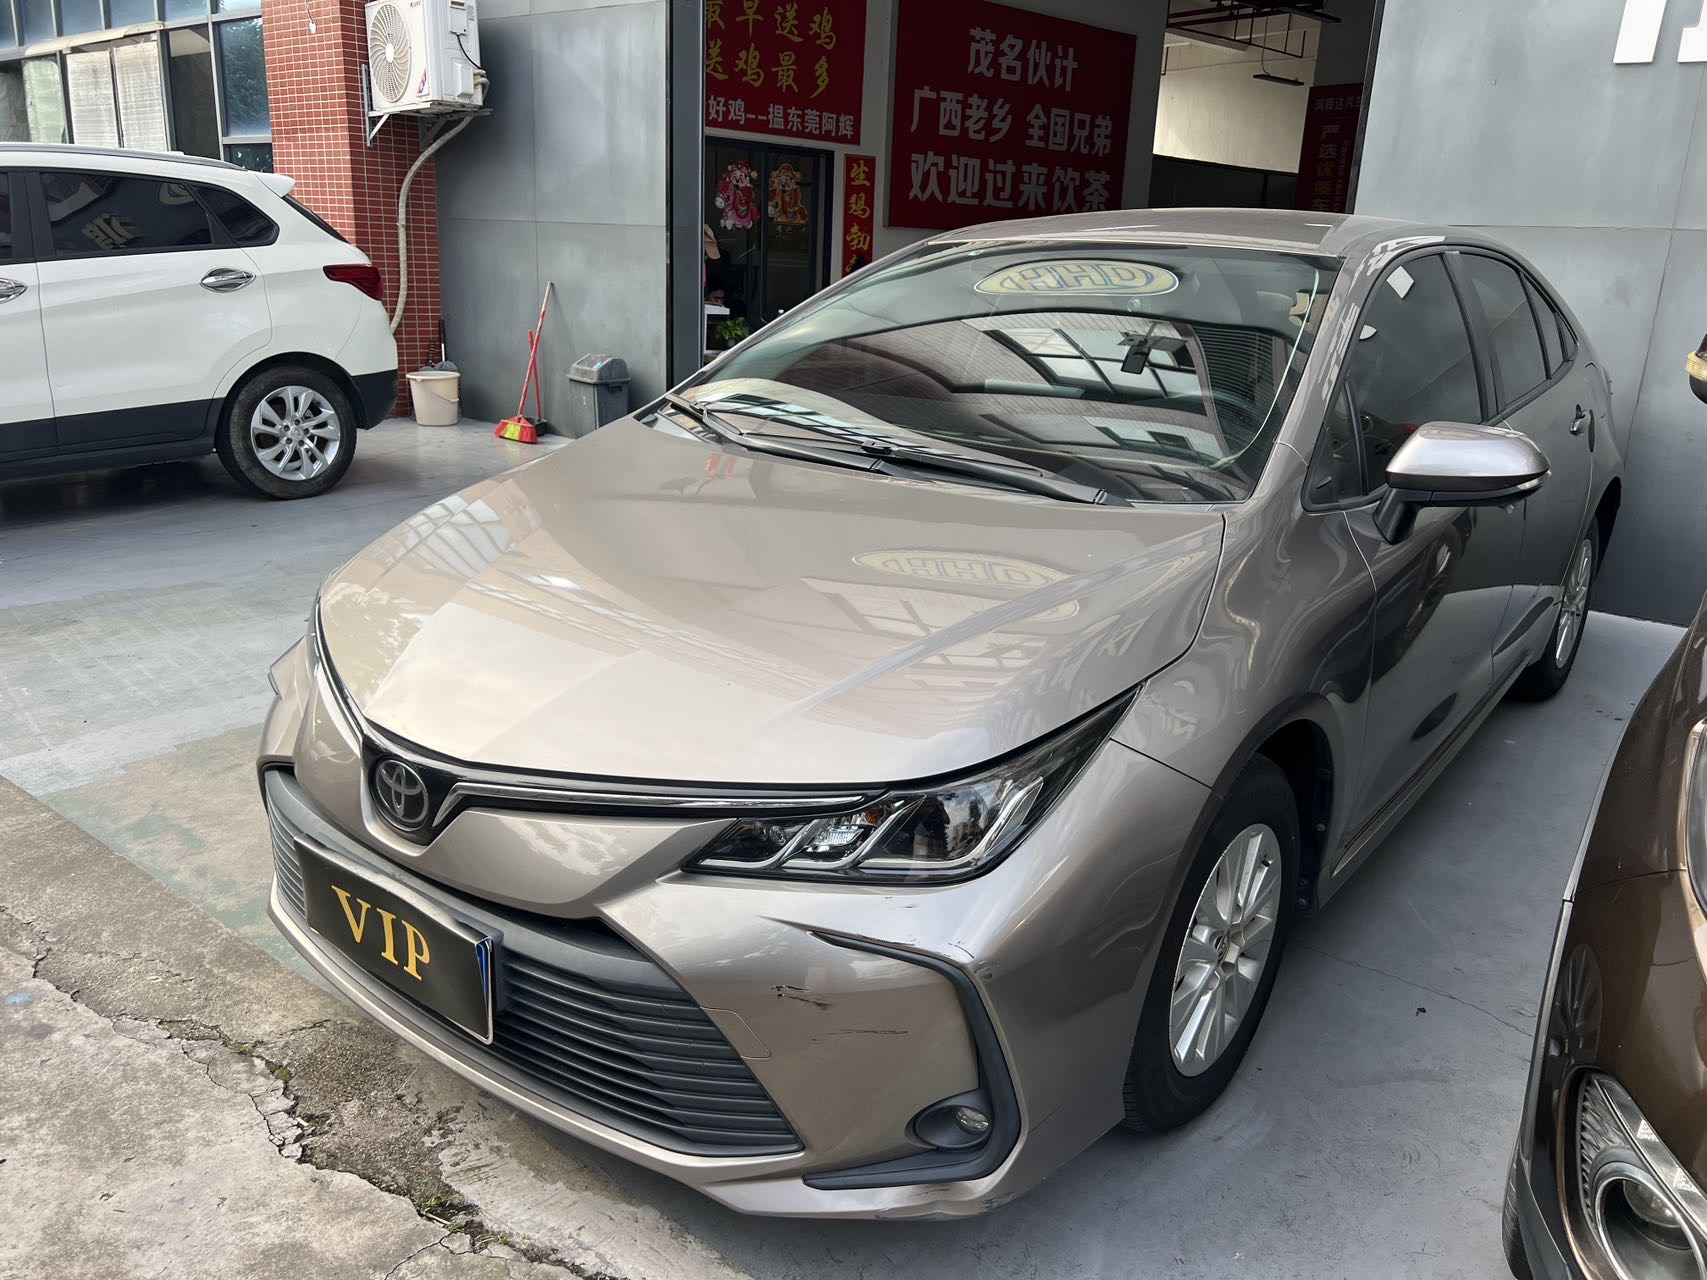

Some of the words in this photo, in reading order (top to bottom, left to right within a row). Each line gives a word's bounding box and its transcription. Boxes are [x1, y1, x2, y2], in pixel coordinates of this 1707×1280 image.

[705, 38, 829, 99] 送鸡最多
[967, 27, 1078, 92] 茂名伙计
[910, 86, 1013, 143] 广西老乡
[1025, 103, 1113, 157] 全国兄弟
[908, 151, 1111, 213] 欢迎过来饮茶
[331, 884, 431, 981] VIP
